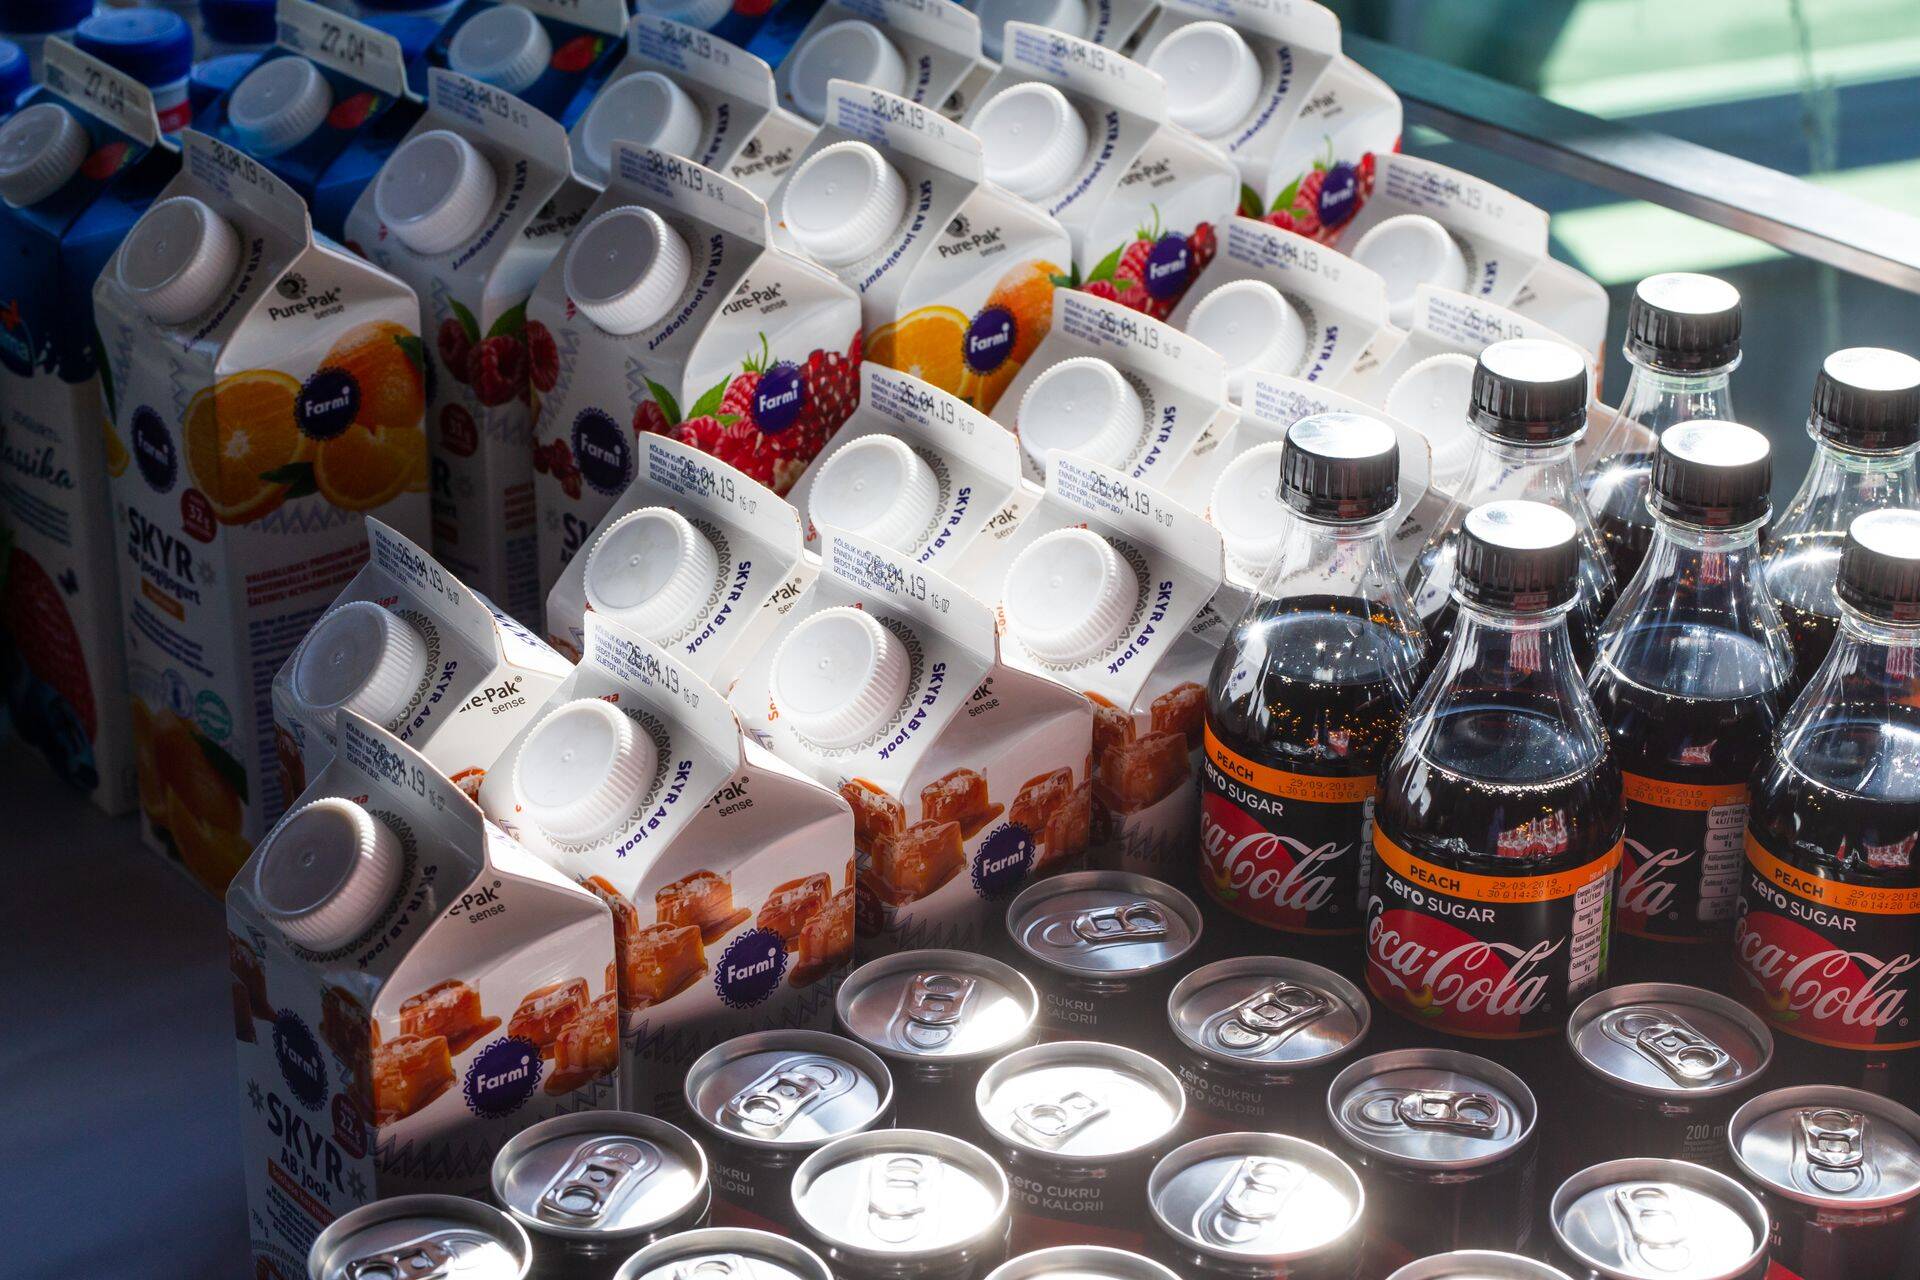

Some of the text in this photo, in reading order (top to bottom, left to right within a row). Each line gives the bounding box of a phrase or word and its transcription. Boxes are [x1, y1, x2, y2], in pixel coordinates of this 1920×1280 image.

[919, 179, 932, 212] SKYR
[710, 233, 725, 268] SKYR
[1149, 248, 1188, 281] Farmi
[702, 269, 718, 288] AB
[970, 321, 1011, 354] Farmi
[1318, 324, 1339, 365] SKYR
[303, 385, 352, 419] Farmi
[759, 379, 799, 413] Farmi
[580, 431, 623, 469] Farmi
[1141, 405, 1177, 473] SKYR AB
[933, 486, 972, 551] SKYR AB
[128, 506, 196, 584] SKYR
[686, 560, 752, 656] SKYR AB jook
[1191, 614, 1224, 636] sense
[1106, 580, 1174, 675] SKYR AB jook
[411, 660, 459, 729] SKYR AB
[491, 694, 527, 716] sense
[877, 661, 947, 761] SKYR AB jook
[967, 696, 1001, 719] sense
[1216, 749, 1254, 783] PEACH
[1203, 756, 1285, 817] zero SUGAR
[615, 759, 693, 860] SKYR AB jook
[717, 796, 754, 819] sense
[982, 840, 1027, 878] Farmi
[1409, 863, 1461, 893] PEACH
[1491, 878, 1559, 891] 29/09/2019
[1775, 867, 1825, 899] PEACH
[467, 902, 507, 925] sense
[1383, 871, 1497, 924] zero SUGAR
[1751, 873, 1858, 933] zero SUGAR
[356, 864, 438, 969] SKYR AB jook
[726, 948, 777, 985] Farmi
[1366, 894, 1567, 1017] Coca-Cola
[1047, 992, 1095, 1013] CUKRU
[476, 1054, 531, 1094] Farmi
[1178, 1064, 1262, 1104] zero CUKRU
[1207, 1095, 1266, 1117] KALORII
[267, 1091, 346, 1194] SKYR
[1685, 1124, 1710, 1142] 200
[280, 1146, 299, 1176] AB
[300, 1166, 332, 1206] jook
[1005, 1171, 1101, 1200] zero CUKRU
[1042, 1197, 1104, 1213] KALORII
